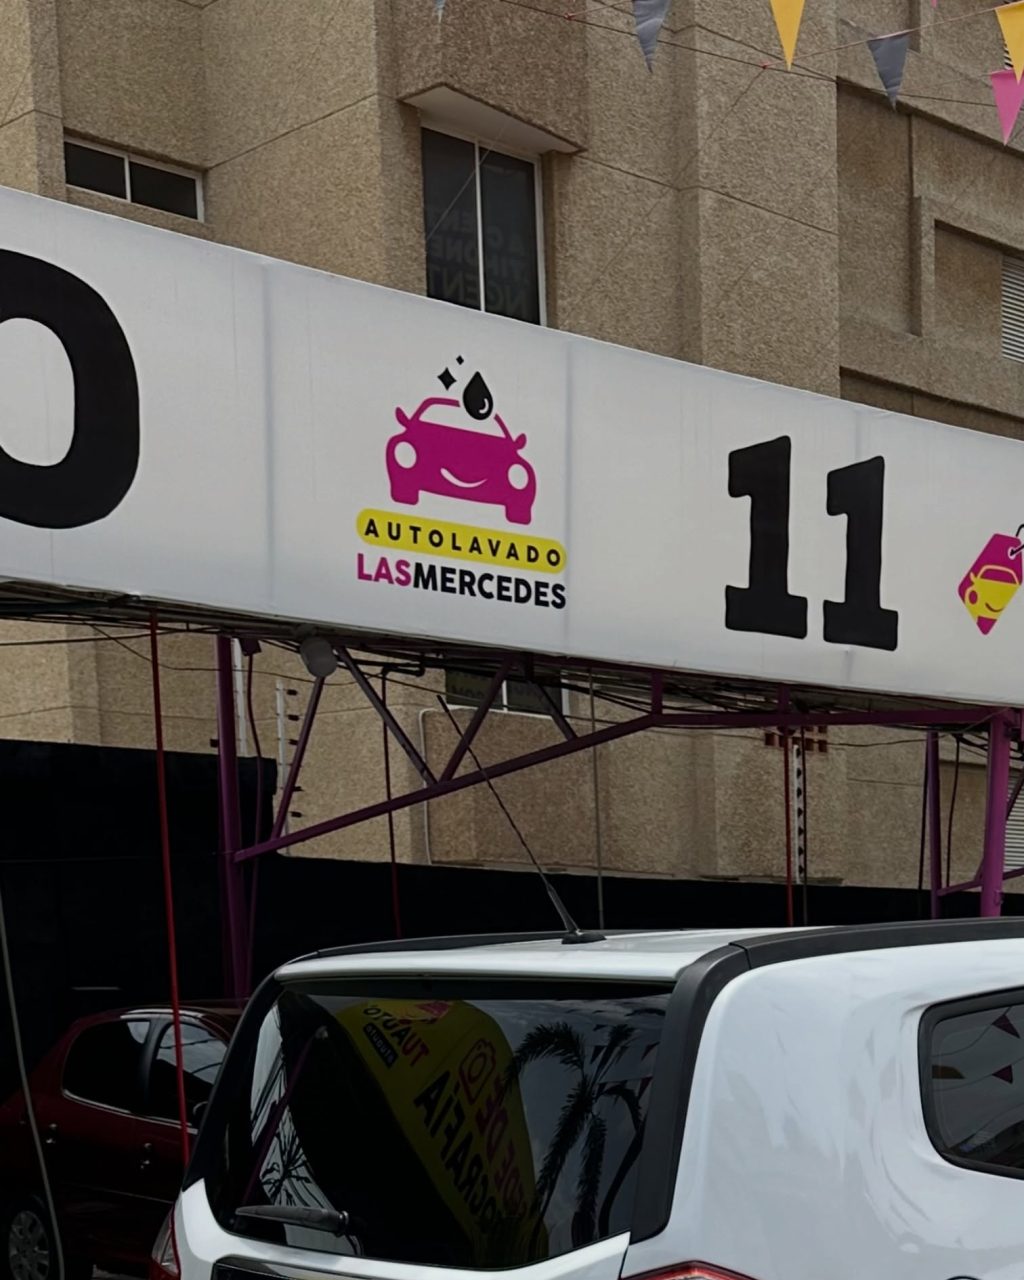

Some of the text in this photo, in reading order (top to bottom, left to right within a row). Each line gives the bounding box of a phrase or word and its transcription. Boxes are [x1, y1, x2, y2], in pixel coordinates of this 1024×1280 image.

[364, 516, 562, 567] AUTOLAVADO
[724, 435, 898, 651] 11
[356, 552, 566, 609] LASMERCEDES
